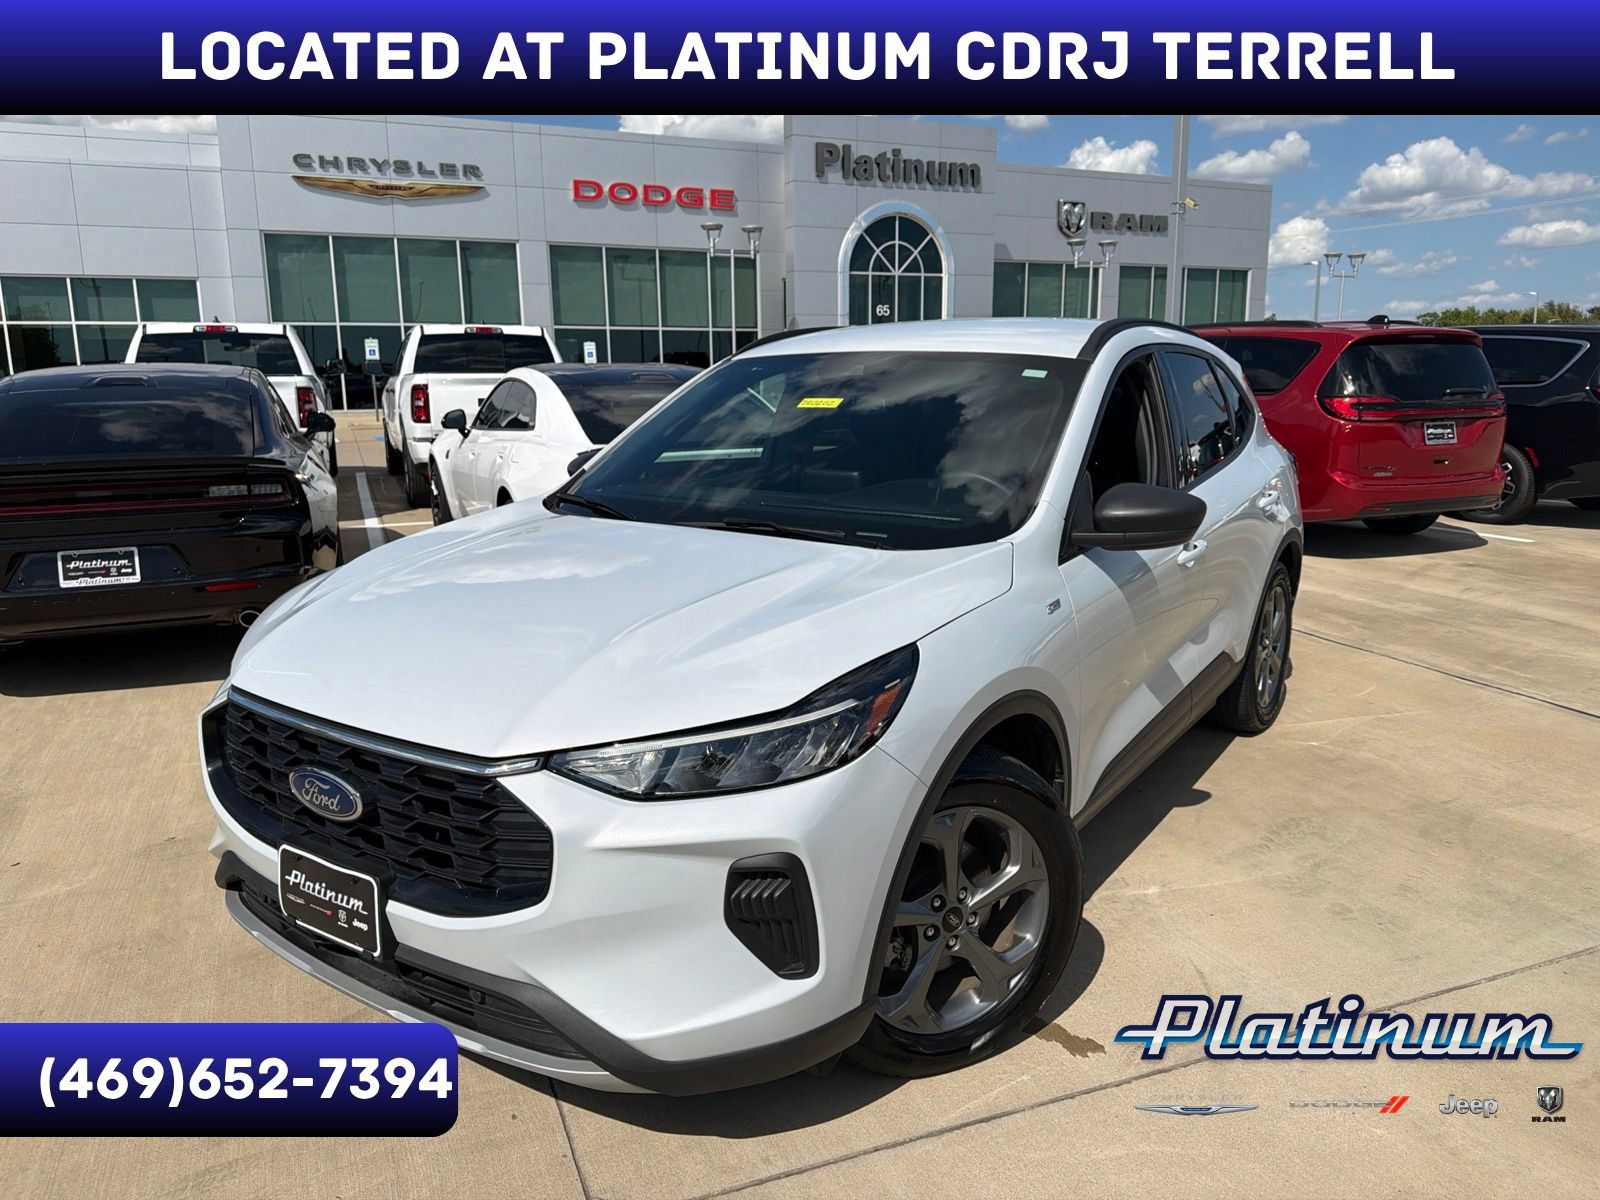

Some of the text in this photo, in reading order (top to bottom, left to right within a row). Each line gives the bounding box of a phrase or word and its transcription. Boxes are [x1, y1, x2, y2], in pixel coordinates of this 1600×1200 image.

[292, 153, 482, 178] CHRYSLER
[815, 141, 982, 187] Platinum
[573, 179, 736, 211] DODGE
[1090, 211, 1169, 233] RAM
[876, 304, 890, 316] 65
[66, 559, 132, 569] Platinum
[302, 778, 341, 811] Ford
[285, 869, 368, 915] Platinum
[352, 918, 369, 932] Jeep
